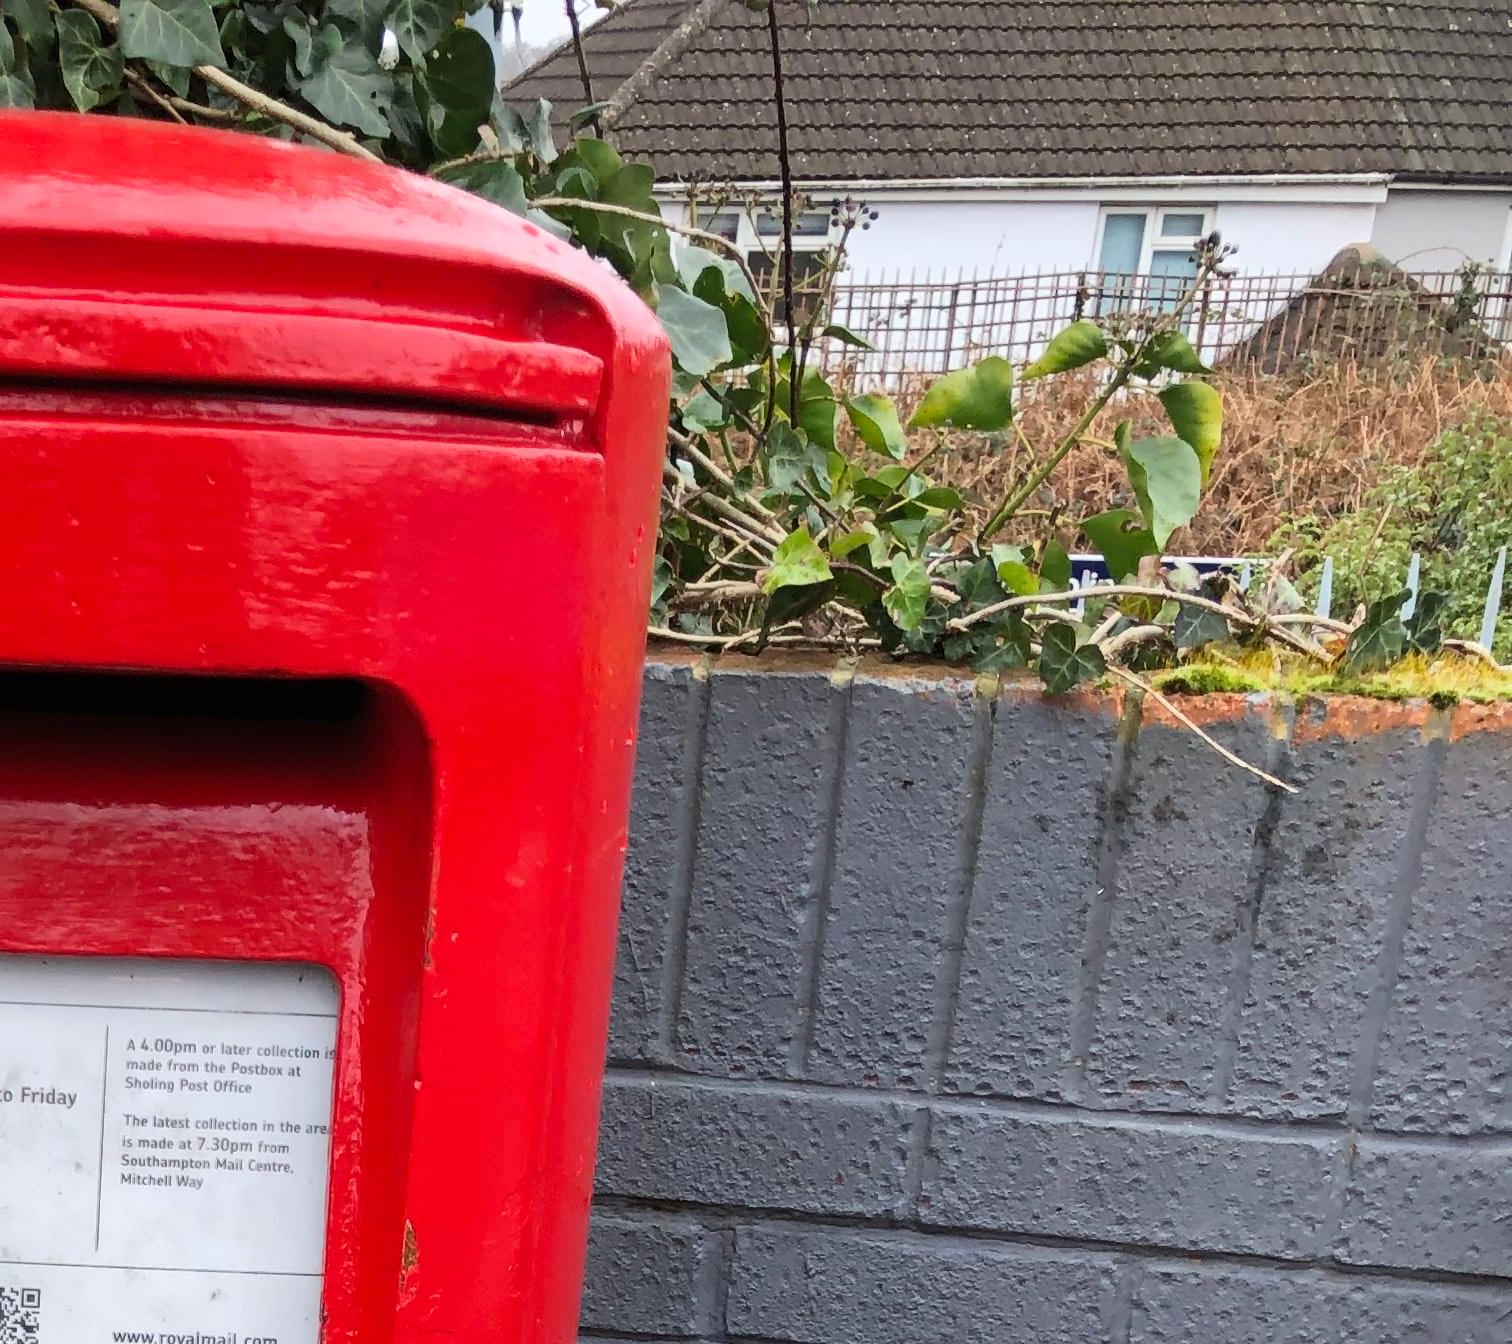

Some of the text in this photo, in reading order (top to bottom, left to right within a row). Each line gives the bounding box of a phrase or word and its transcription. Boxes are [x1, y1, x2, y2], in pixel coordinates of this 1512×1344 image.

[126, 1039, 136, 1051] A
[140, 1038, 197, 1056] 4.00pm
[202, 1044, 217, 1055] or
[221, 1042, 252, 1057] later
[257, 1044, 320, 1060] collection
[126, 1059, 302, 1077] made from the Postbox at
[125, 1076, 253, 1094] Sholing Post Office
[21, 1087, 78, 1109] Friday
[123, 1113, 330, 1136] The latest collection in the are
[122, 1135, 289, 1154] is made at 7.30pm from
[121, 1154, 210, 1171] Southampton
[215, 1158, 243, 1171] Mail
[120, 1173, 203, 1191] Mitchell Way
